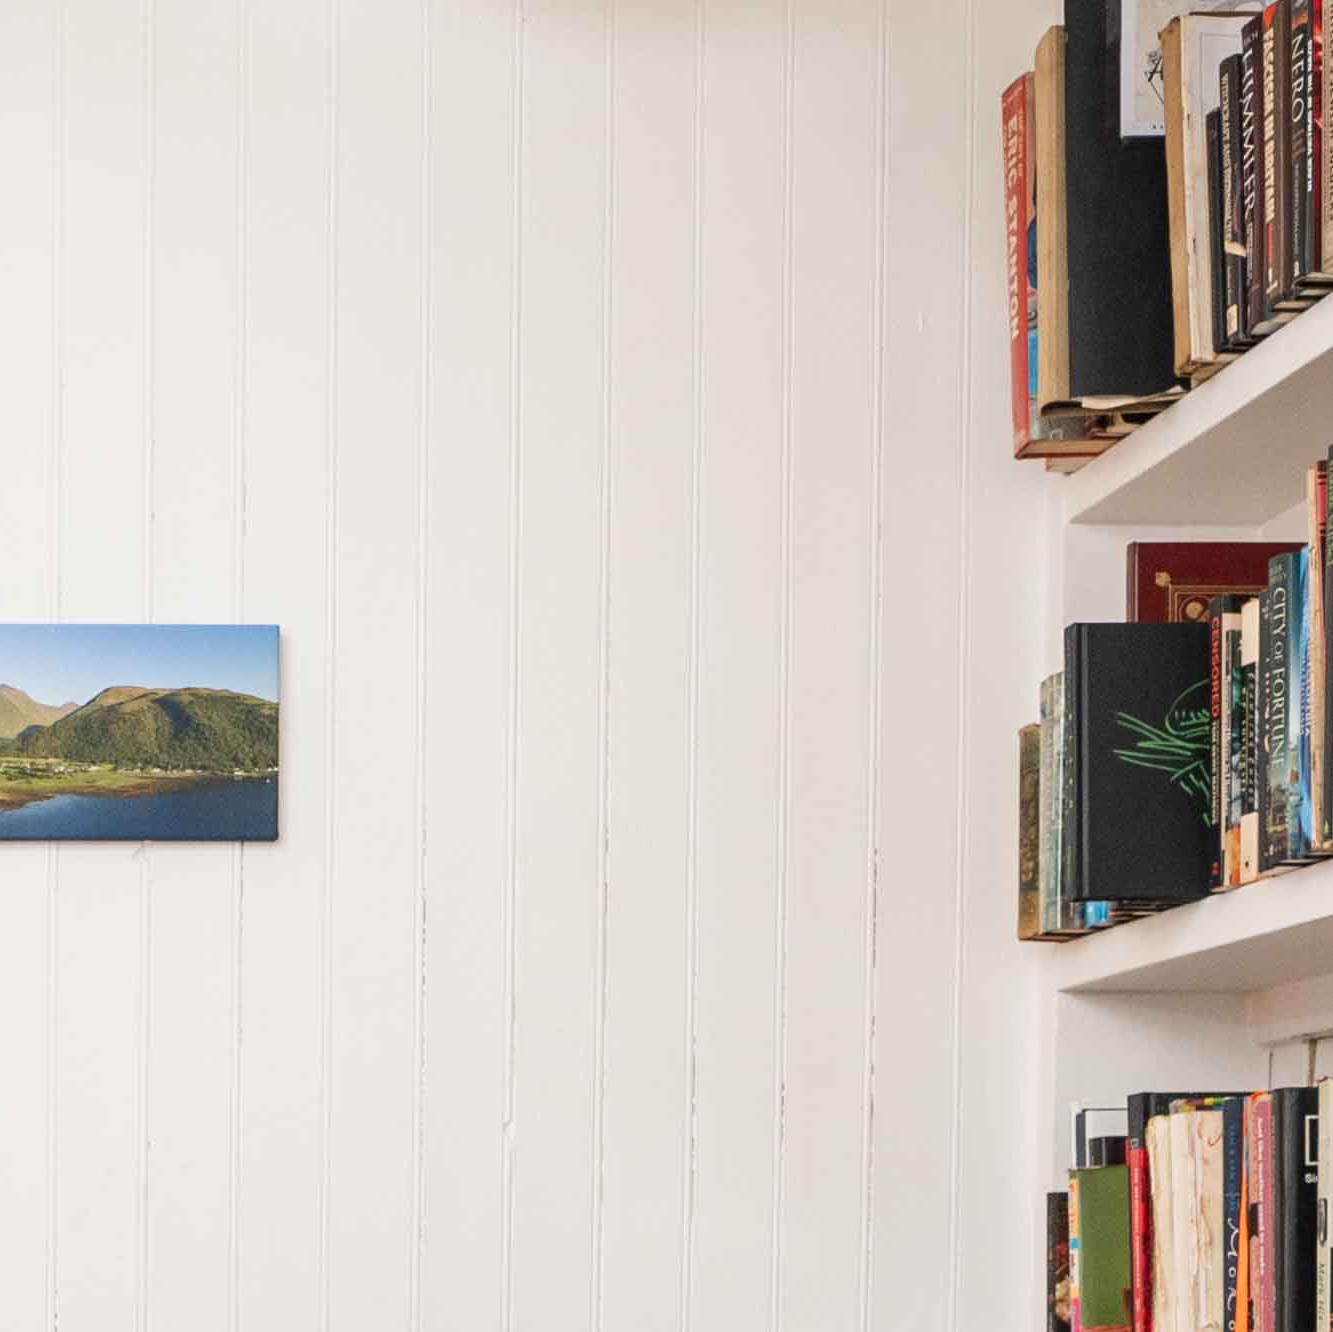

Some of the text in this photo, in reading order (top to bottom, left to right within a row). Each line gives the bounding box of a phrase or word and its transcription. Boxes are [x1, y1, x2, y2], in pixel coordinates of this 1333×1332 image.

[1262, 27, 1275, 116] FASCISM
[1291, 32, 1305, 123] NERO
[1242, 47, 1256, 220] HIMMLER
[1006, 113, 1020, 341] ERIC STANTON
[1264, 140, 1275, 224] BRITAIN
[1273, 586, 1287, 637] CITY
[1273, 641, 1284, 663] OF
[1211, 616, 1221, 719] CENSORED
[1271, 667, 1286, 769] FORTUNE
